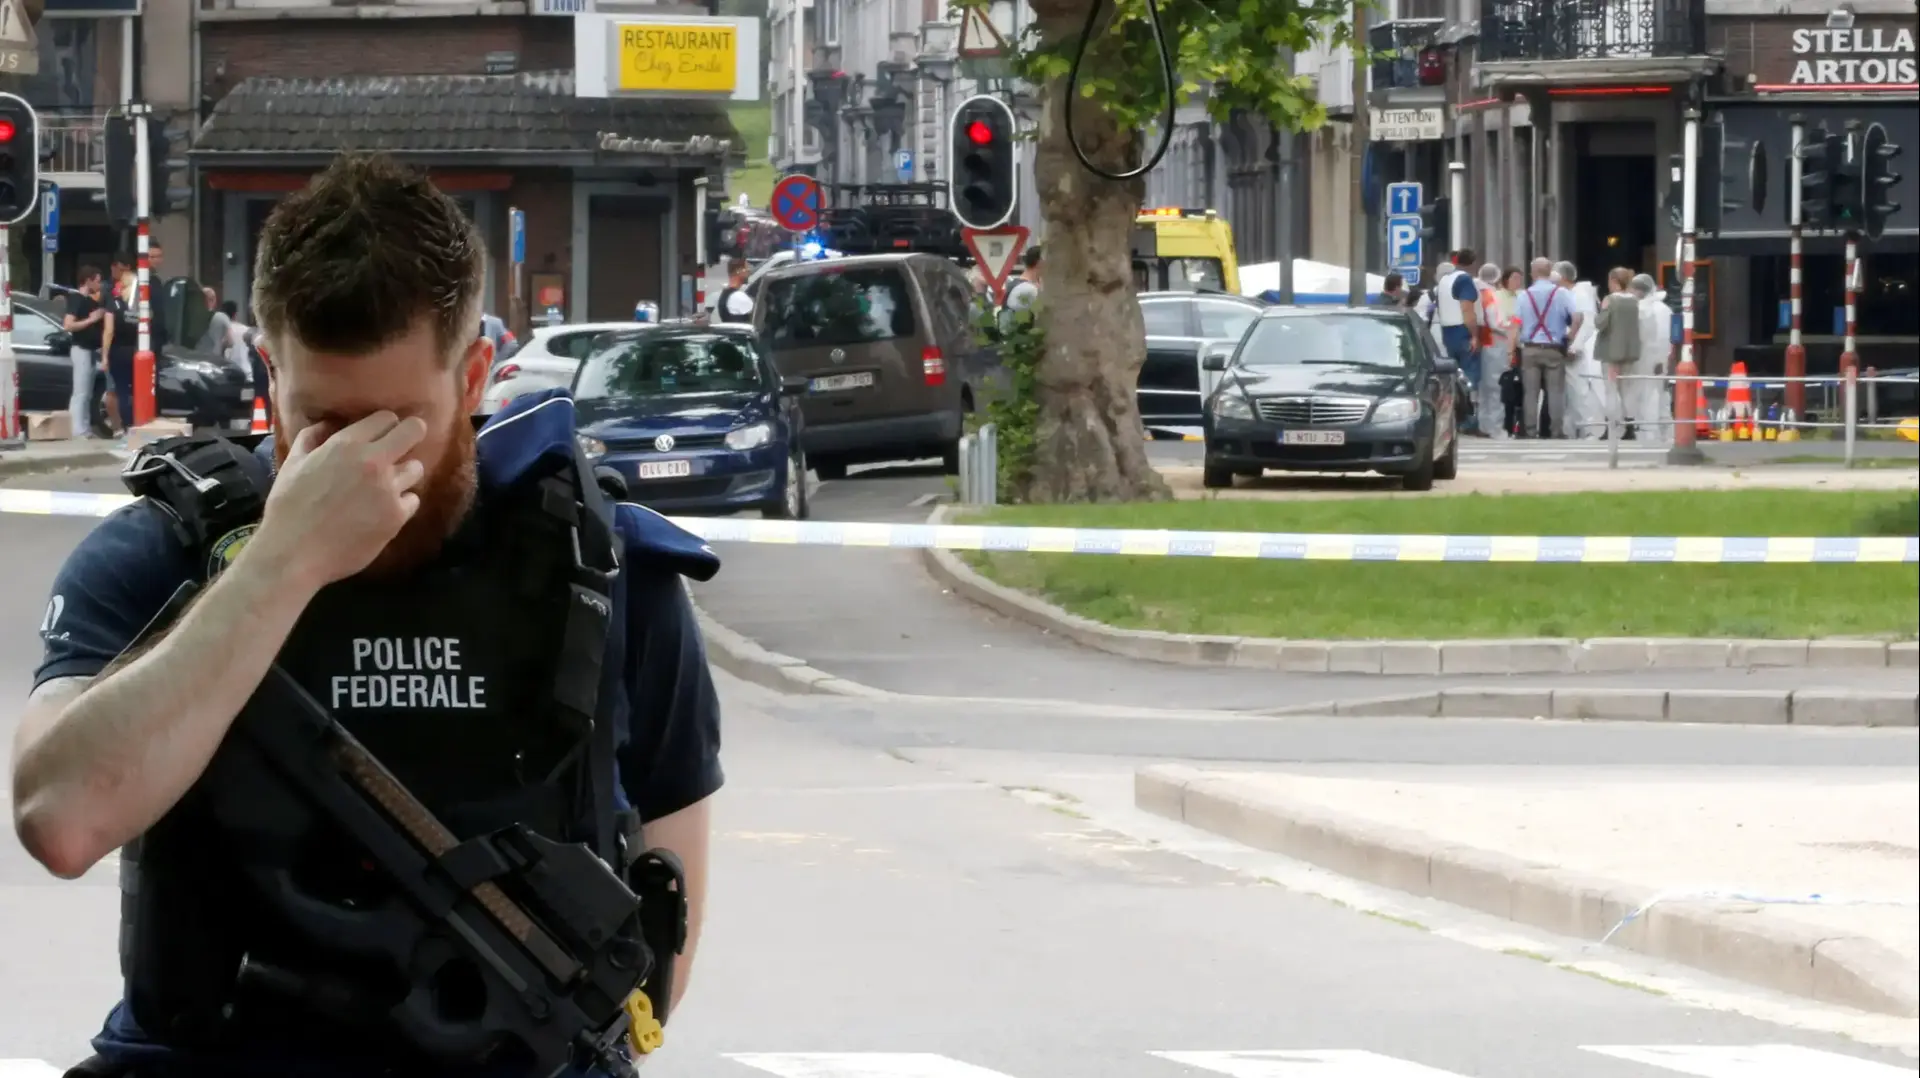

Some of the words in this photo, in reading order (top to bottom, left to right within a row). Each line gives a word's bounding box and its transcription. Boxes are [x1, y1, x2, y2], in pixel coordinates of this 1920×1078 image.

[624, 29, 731, 50] RESTAURANT
[1792, 28, 1916, 54] STELLA
[634, 52, 673, 82] Chez
[677, 53, 724, 74] Emile
[1791, 58, 1917, 84] ARTOIS
[1392, 224, 1416, 259] P
[353, 637, 462, 672] POLICE
[332, 675, 487, 709] FEDERALE
